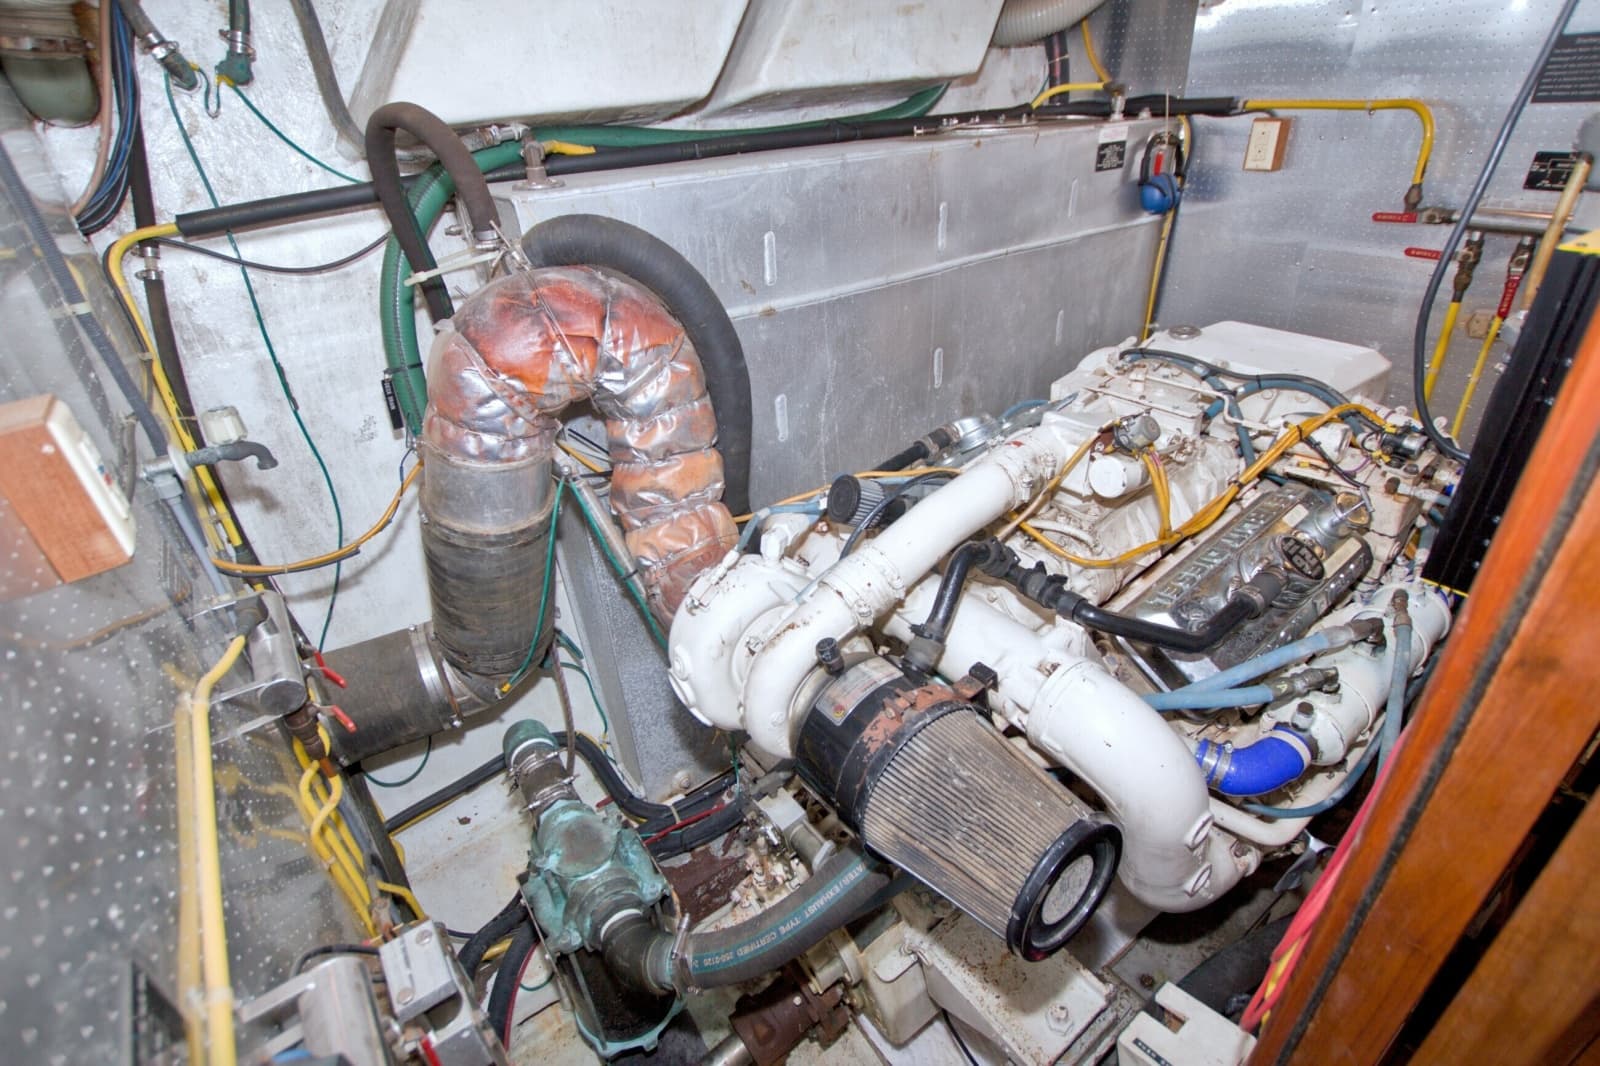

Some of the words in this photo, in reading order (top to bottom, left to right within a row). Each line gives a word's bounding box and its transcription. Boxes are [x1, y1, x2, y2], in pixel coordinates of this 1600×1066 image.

[1146, 547, 1231, 606] DIESEL
[779, 917, 801, 935] TYPE
[736, 931, 777, 956] CERTIFIED
